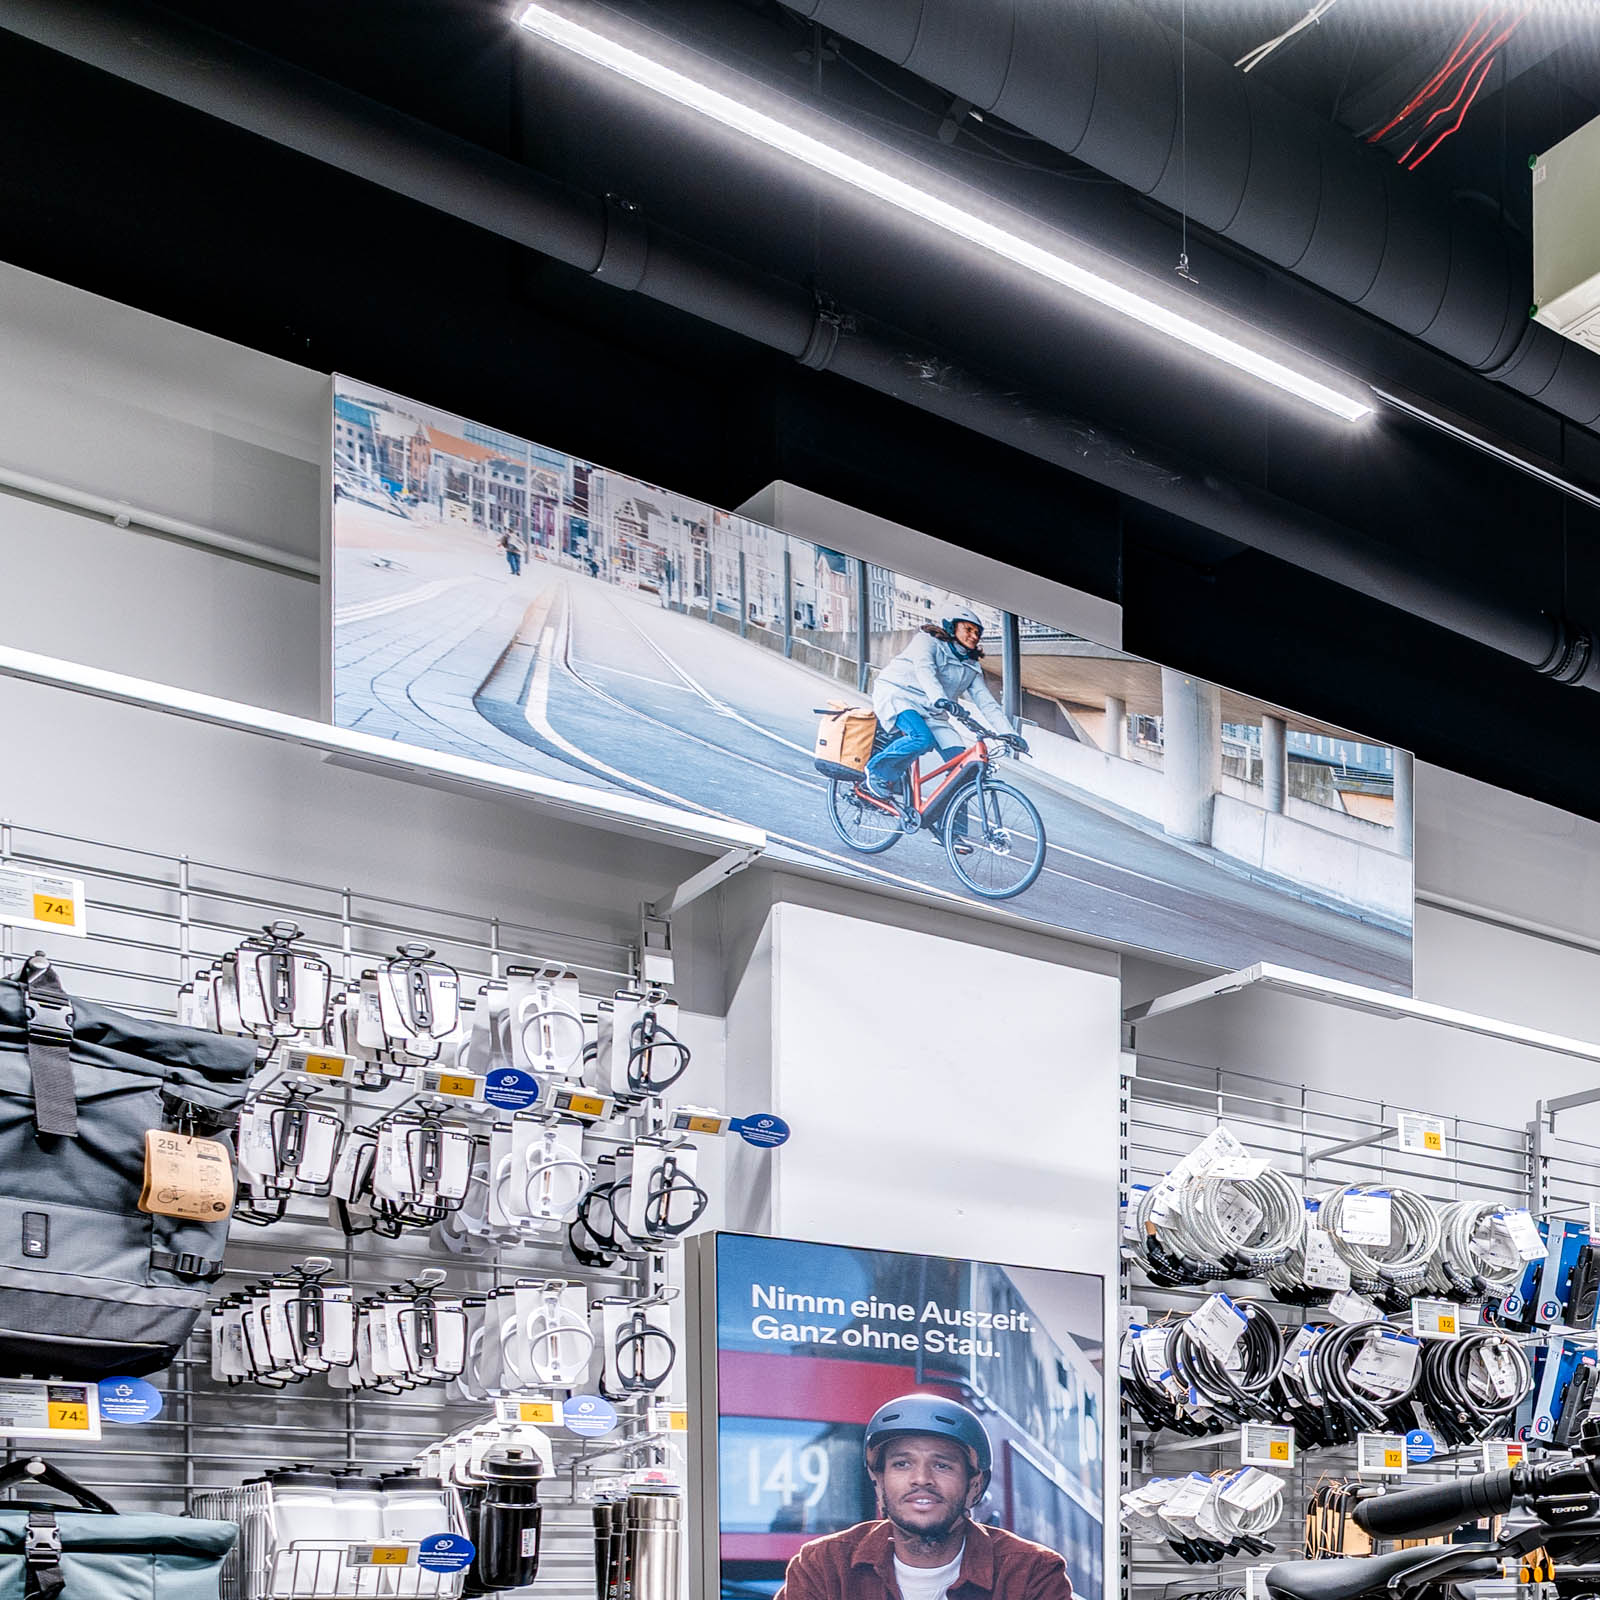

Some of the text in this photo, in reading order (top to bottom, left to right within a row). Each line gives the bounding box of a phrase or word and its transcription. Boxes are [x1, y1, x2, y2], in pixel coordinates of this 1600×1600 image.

[158, 1138, 183, 1152] 25L
[752, 1283, 1037, 1333] Nimm eine Auszeit.
[752, 1315, 1001, 1358] Ganz ohne Stau.
[747, 1444, 830, 1506] 149
